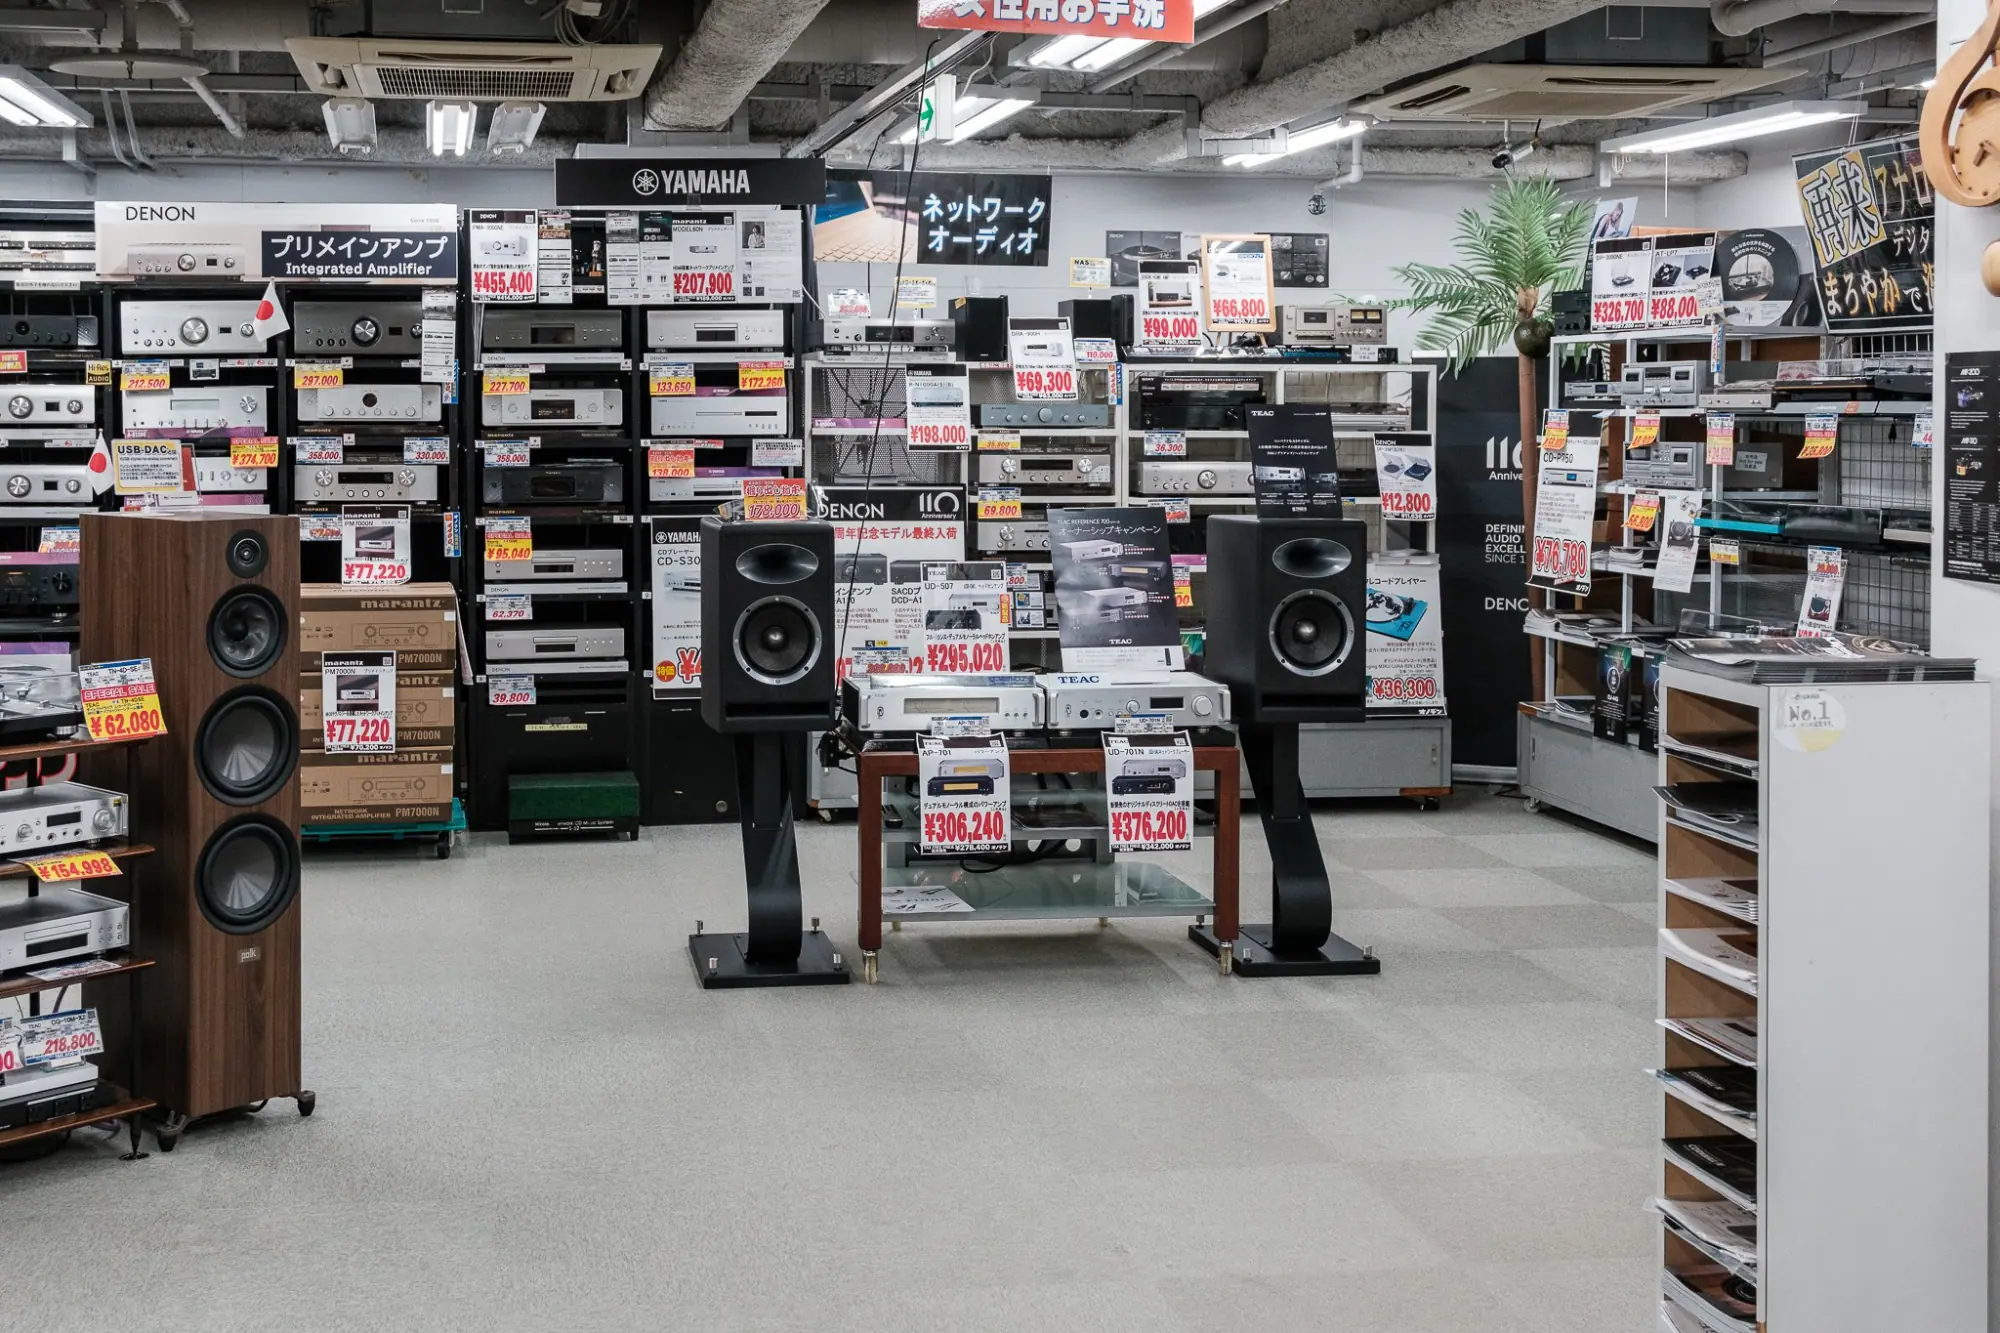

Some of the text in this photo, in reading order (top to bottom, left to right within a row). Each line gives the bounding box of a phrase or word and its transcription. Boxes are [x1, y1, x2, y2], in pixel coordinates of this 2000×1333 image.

[661, 169, 750, 194] YAMAHA
[126, 206, 196, 221] DENON
[922, 192, 1046, 223] ネットワーク
[271, 234, 449, 259] プリメインアンプ
[928, 224, 1038, 255] オーディオ
[1892, 226, 1931, 257] デジタ
[286, 262, 433, 276] Integrated Amplifier
[474, 271, 533, 294] ¥455,400
[673, 271, 733, 296] ¥207,900
[1213, 298, 1266, 319] ¥66,800
[1594, 299, 1645, 323] ¥326,700
[1143, 317, 1198, 340] ¥99,000
[1016, 371, 1072, 394] ¥69,300
[910, 425, 966, 444] ¥198,000
[1485, 436, 1524, 469] 11
[817, 503, 884, 519] DENON
[919, 492, 960, 512] 110
[1382, 492, 1432, 513] ¥12,800
[921, 512, 957, 520] Anniversary
[668, 532, 702, 543] YAMAH
[834, 527, 957, 540] 周年記念モデル最終入荷
[1059, 525, 1161, 535] オーナーシップキャンペーン
[1485, 534, 1521, 543] AUDIO
[1485, 554, 1516, 563] SINCE
[1534, 535, 1588, 579] ¥76,780
[344, 563, 406, 580] ¥77,220
[360, 598, 442, 609] marantz
[398, 653, 442, 663] PM7000N
[927, 643, 1004, 673] ¥295,020
[398, 676, 442, 685] antz
[656, 665, 675, 676] 特価
[1057, 675, 1100, 684] TEAC
[84, 684, 155, 700] SPECIAL SALE
[1373, 677, 1437, 702] ¥36,300
[1789, 700, 1831, 721] No.1
[90, 709, 161, 736] ¥62,080
[326, 719, 390, 743] ¥77,220
[397, 730, 442, 740] PM7000N
[357, 752, 440, 764] marantz
[922, 749, 952, 757] AP-701
[395, 806, 440, 818] PM7000N
[924, 810, 1004, 843] ¥306,240
[1111, 810, 1187, 844] ¥376,200
[37, 857, 113, 880] ¥154,998
[241, 948, 257, 961] polk
